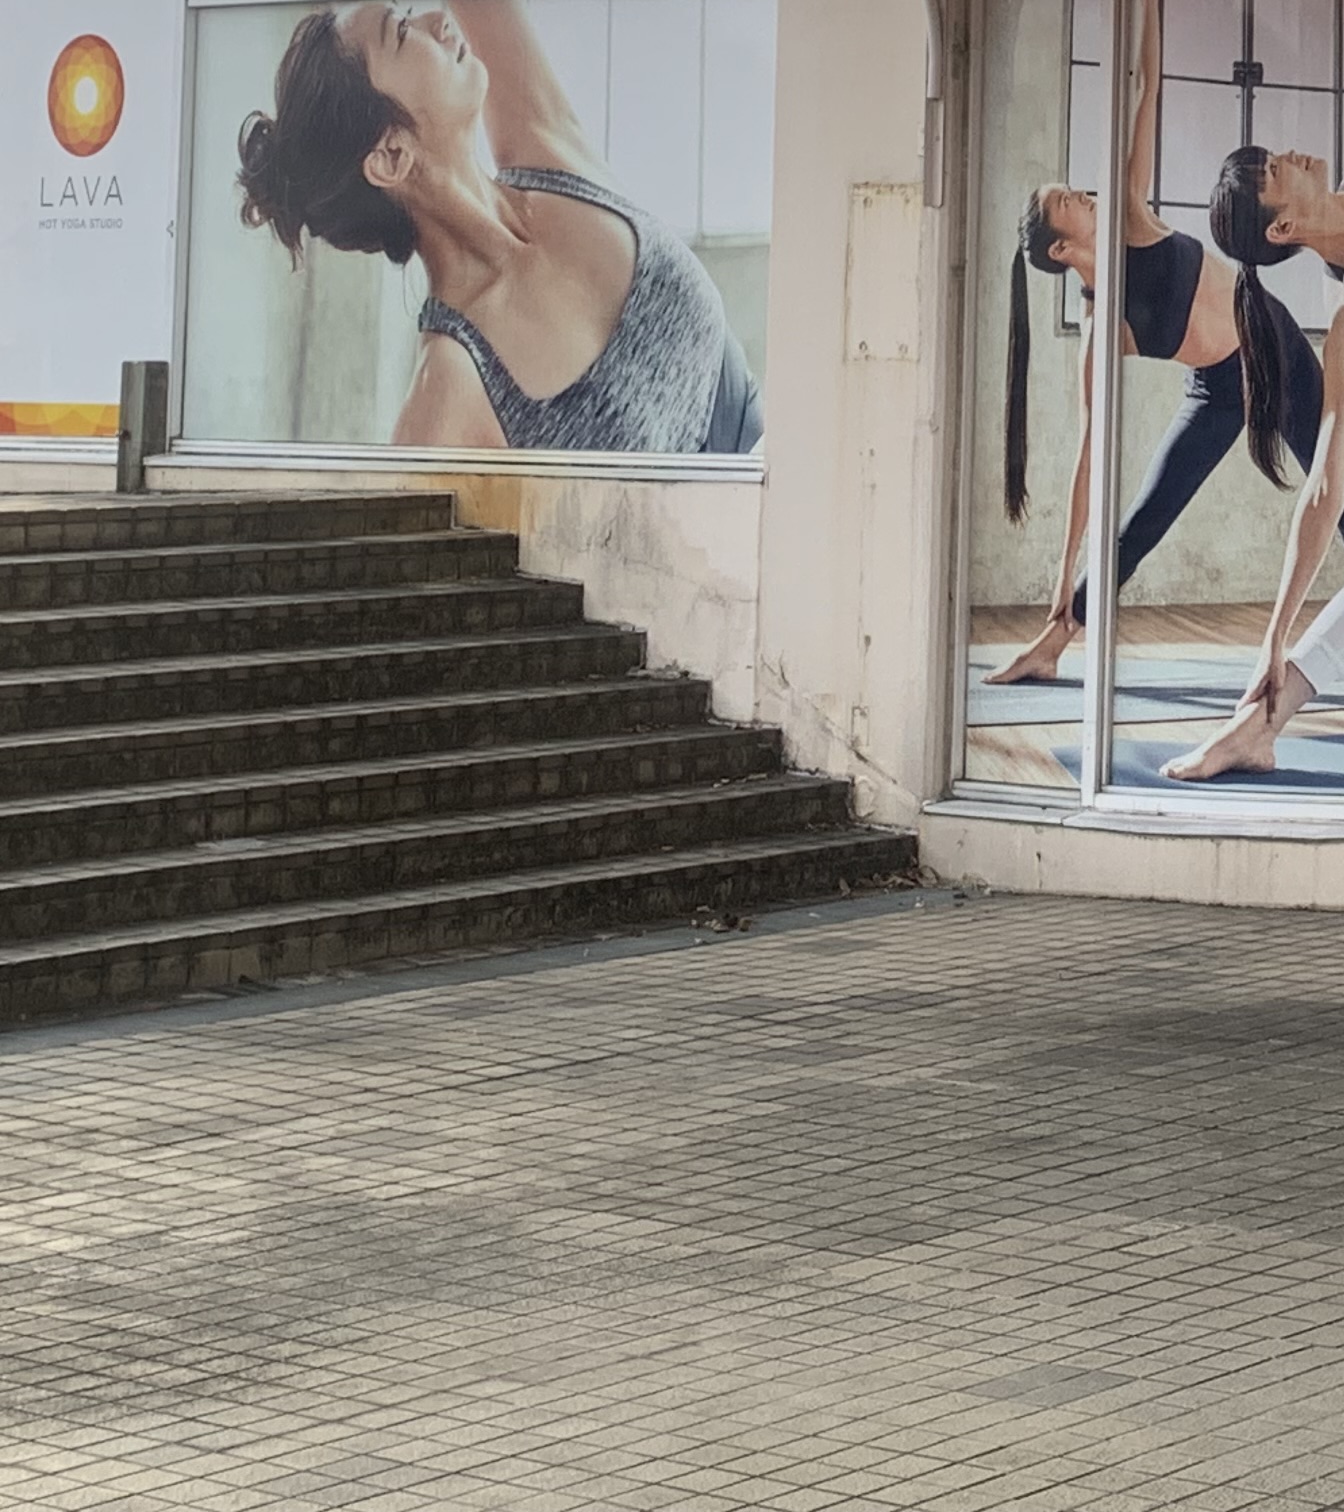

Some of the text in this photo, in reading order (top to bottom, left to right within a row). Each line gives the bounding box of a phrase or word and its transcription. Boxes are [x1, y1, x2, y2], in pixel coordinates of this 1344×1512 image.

[40, 175, 124, 208] LAVA
[38, 218, 123, 230] HOT YOGA STUDIO
